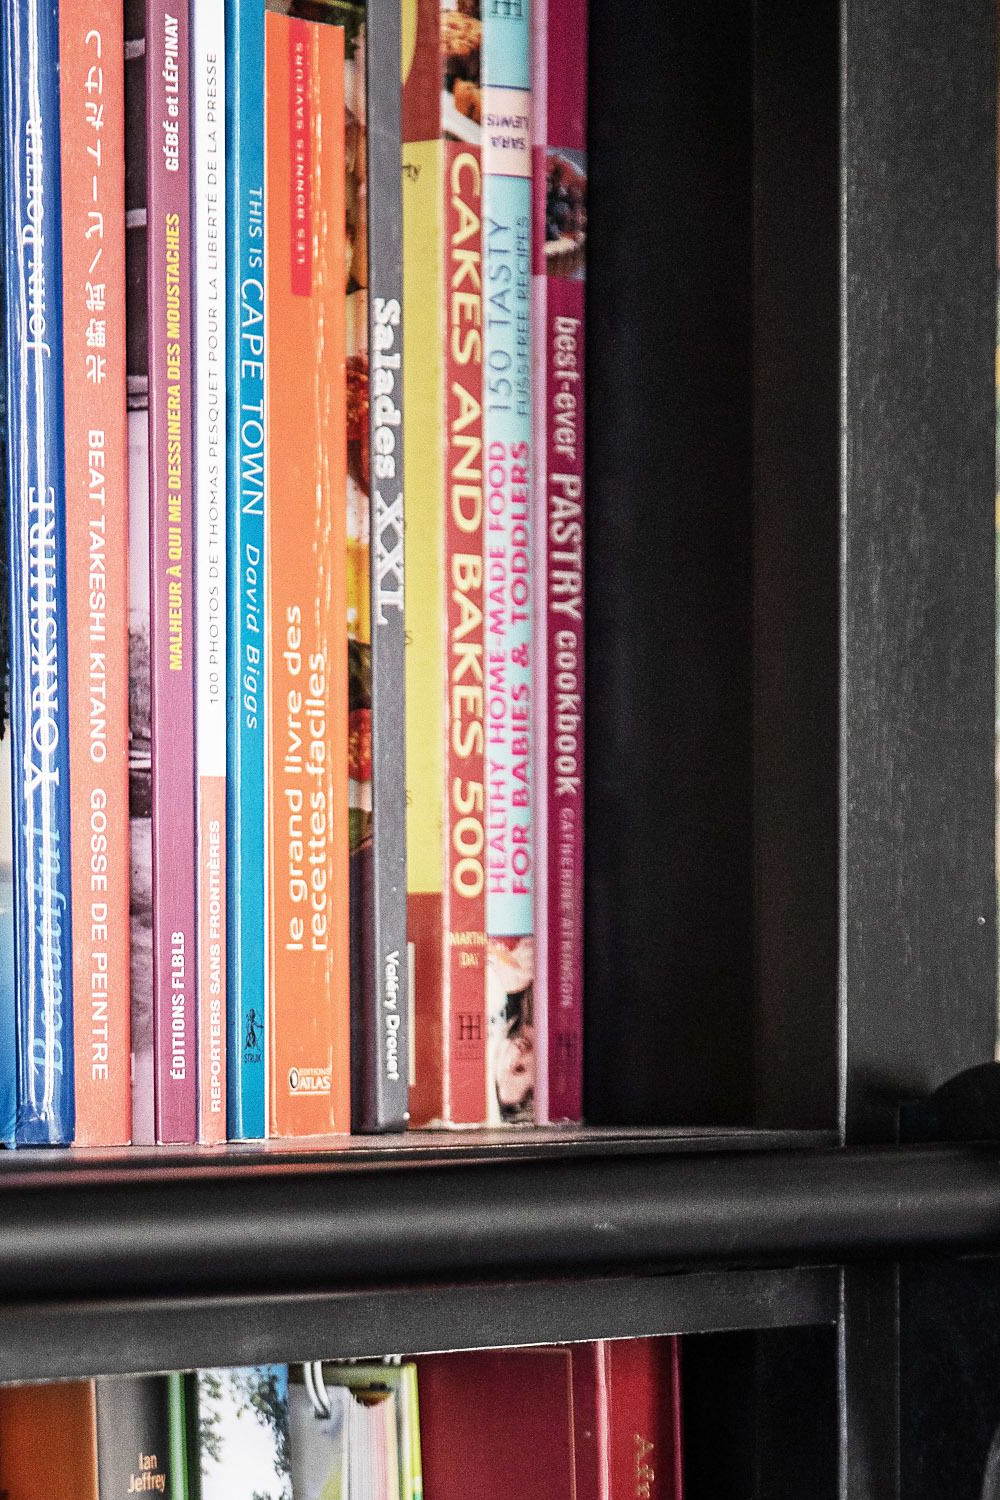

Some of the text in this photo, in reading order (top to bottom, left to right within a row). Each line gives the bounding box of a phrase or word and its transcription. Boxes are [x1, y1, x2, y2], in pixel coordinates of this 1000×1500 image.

[161, 13, 179, 171] GÉBÉ et LÉPINAY
[295, 42, 306, 264] LES BONNES SAVEURS
[487, 114, 529, 129] LEWIS
[491, 136, 526, 150] SARA
[486, 216, 512, 413] 150 TASTY
[514, 216, 529, 300] RECIPES
[165, 213, 183, 671] MALHEUR À QUI ME DESSINERA DES MOUSTACHES
[204, 53, 220, 704] 100 PHOTOS DE THOMAS PESQUET POUR LA LIBERTÉ DE LA PRESSE
[240, 186, 265, 729] THIS IS CAPE TOWN David Biggs
[372, 298, 405, 626] Salades XXL
[552, 316, 582, 461] best-ever
[449, 152, 486, 899] CAKES AND BAKES 500
[550, 472, 582, 622] PASTRY
[488, 440, 509, 893] HEALTHY HOME-MADE FOOD
[510, 440, 532, 894] FOR BABIES & TODDLERS
[554, 630, 584, 797] cookbook
[88, 429, 109, 1081] BEAT TAKESHI KITANO GOSSE DE PEINTRE
[282, 606, 308, 951] le grand livre des
[305, 652, 328, 951] recettes faciles
[558, 807, 576, 915] CATHERINE
[22, 824, 67, 1075] Beautiful
[170, 931, 186, 1080] ÉDITIONS FLBLB
[207, 820, 222, 1112] REPORTERS SANS FRONTIÈRES
[382, 951, 401, 1082] Valéry Drouet
[459, 951, 480, 968] DAY
[559, 917, 575, 1009] ATKINSON
[300, 1076, 331, 1090] ATLAS
[127, 1470, 166, 1493] Jeffrey
[138, 1452, 158, 1471] Ian
